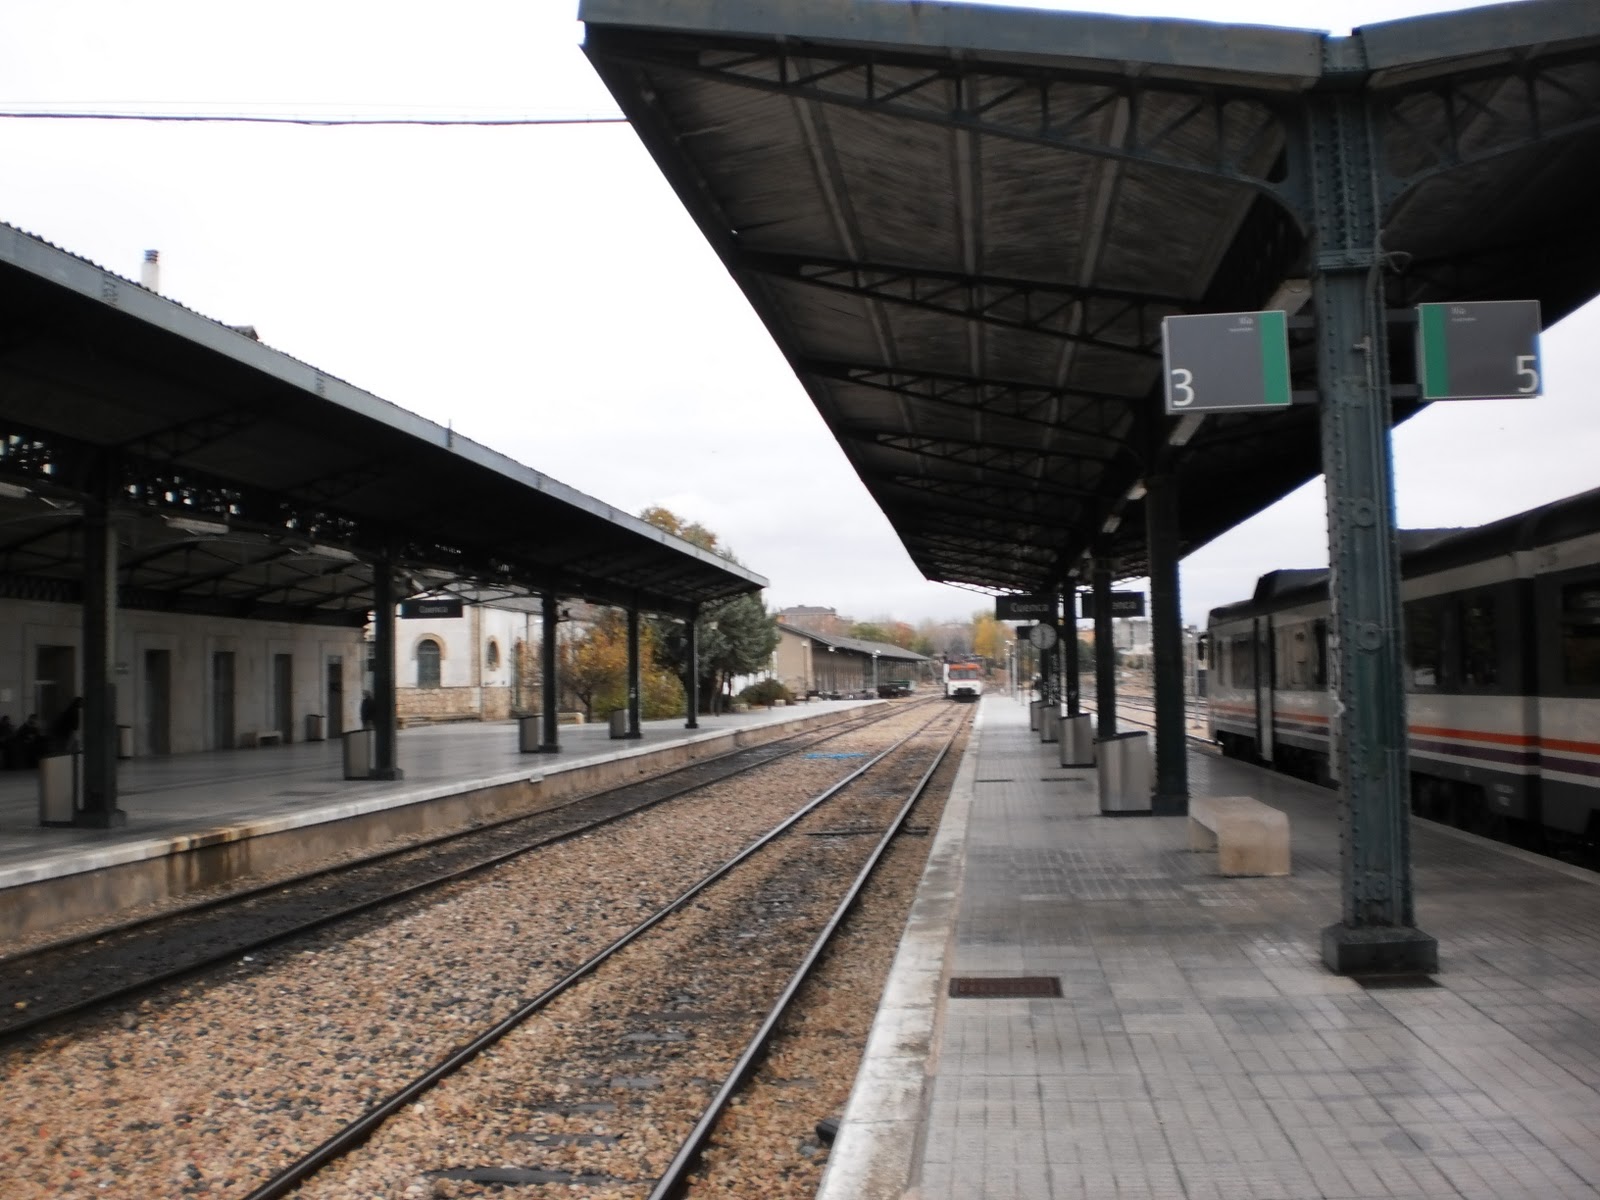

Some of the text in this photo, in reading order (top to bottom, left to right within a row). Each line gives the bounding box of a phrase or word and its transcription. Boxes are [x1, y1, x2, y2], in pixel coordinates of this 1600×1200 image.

[1171, 368, 1194, 406] 3
[1516, 355, 1538, 392] 5
[1010, 602, 1049, 612] Cuenca
